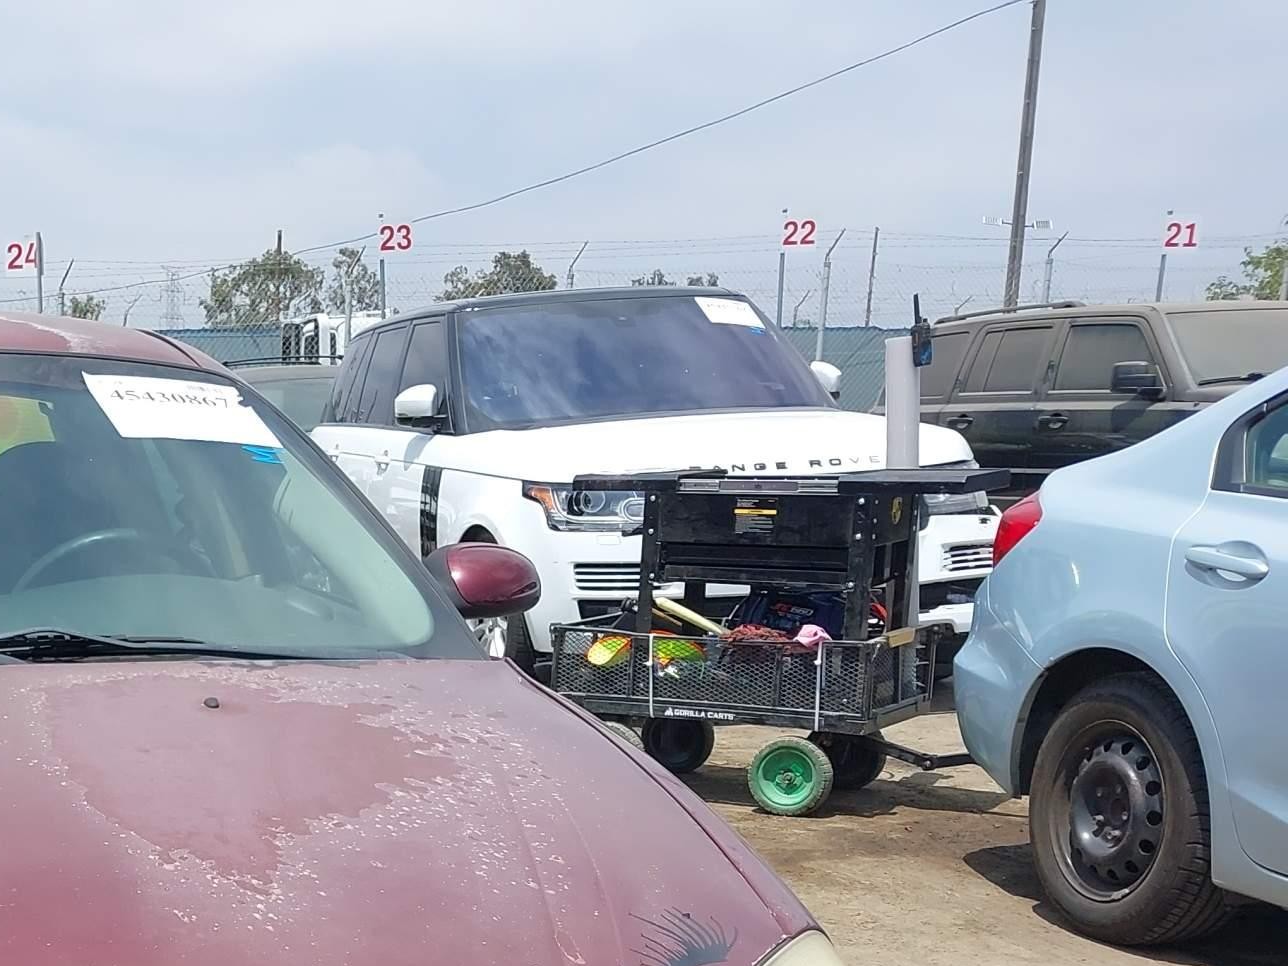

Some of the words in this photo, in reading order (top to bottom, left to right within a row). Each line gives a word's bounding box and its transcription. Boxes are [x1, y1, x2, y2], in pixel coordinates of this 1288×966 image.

[380, 225, 412, 251] 23
[783, 221, 816, 245] 22
[1165, 223, 1198, 247] 21
[8, 243, 37, 269] 24
[110, 389, 228, 409] 45430867
[688, 461, 788, 473] ANGE
[809, 455, 881, 468] ROVE
[674, 708, 706, 718] GORILLA
